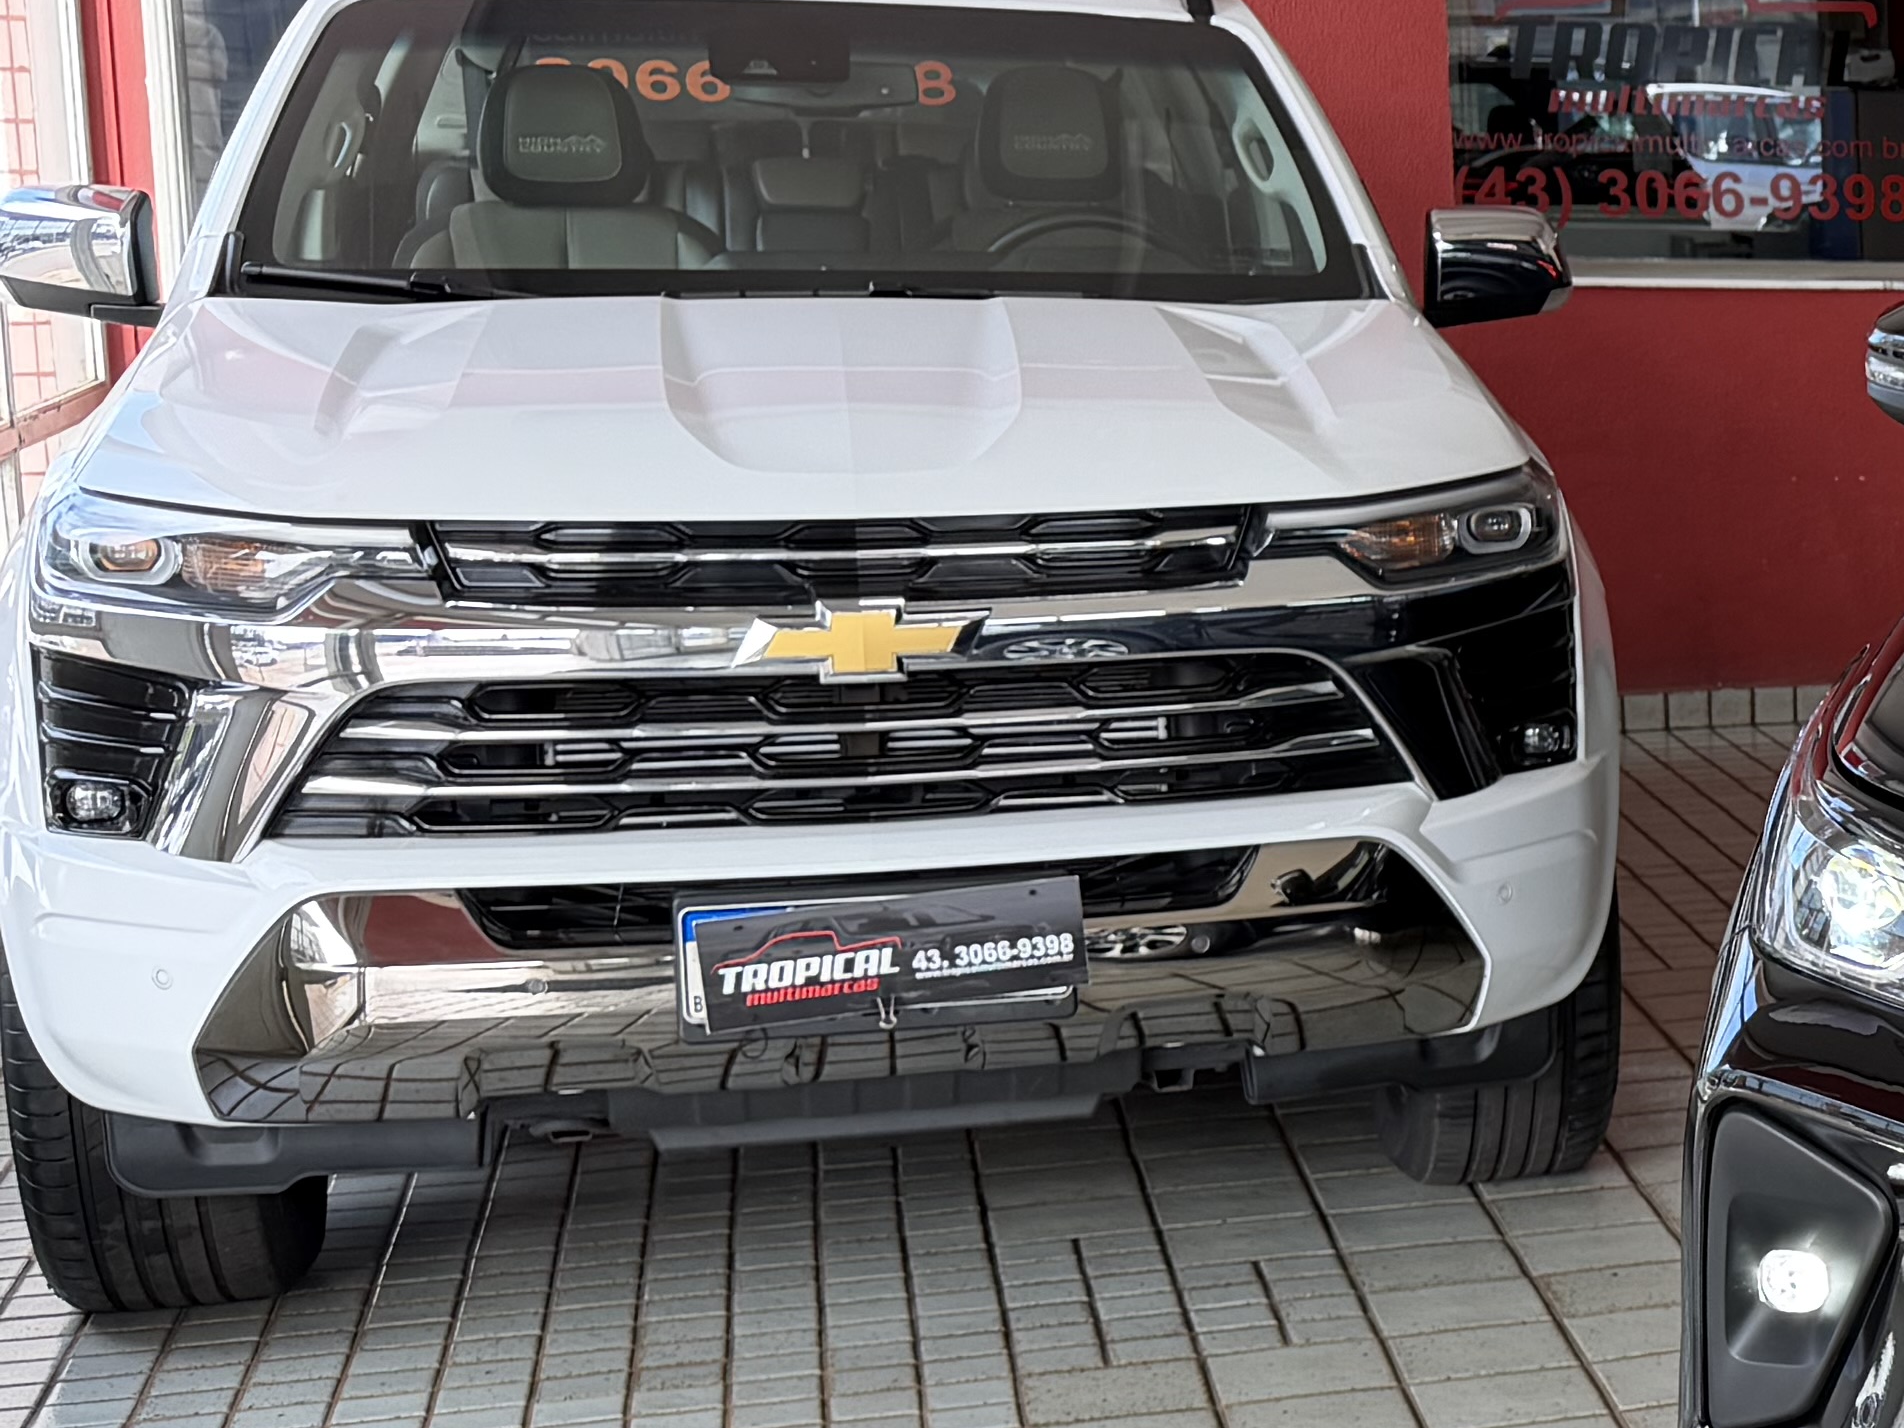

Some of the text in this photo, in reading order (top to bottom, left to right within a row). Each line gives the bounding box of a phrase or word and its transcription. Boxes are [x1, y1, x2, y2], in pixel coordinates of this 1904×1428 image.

[718, 947, 900, 995] TROPICAL
[954, 933, 1075, 966] 3066-9398
[745, 977, 881, 1008] multimarcas
